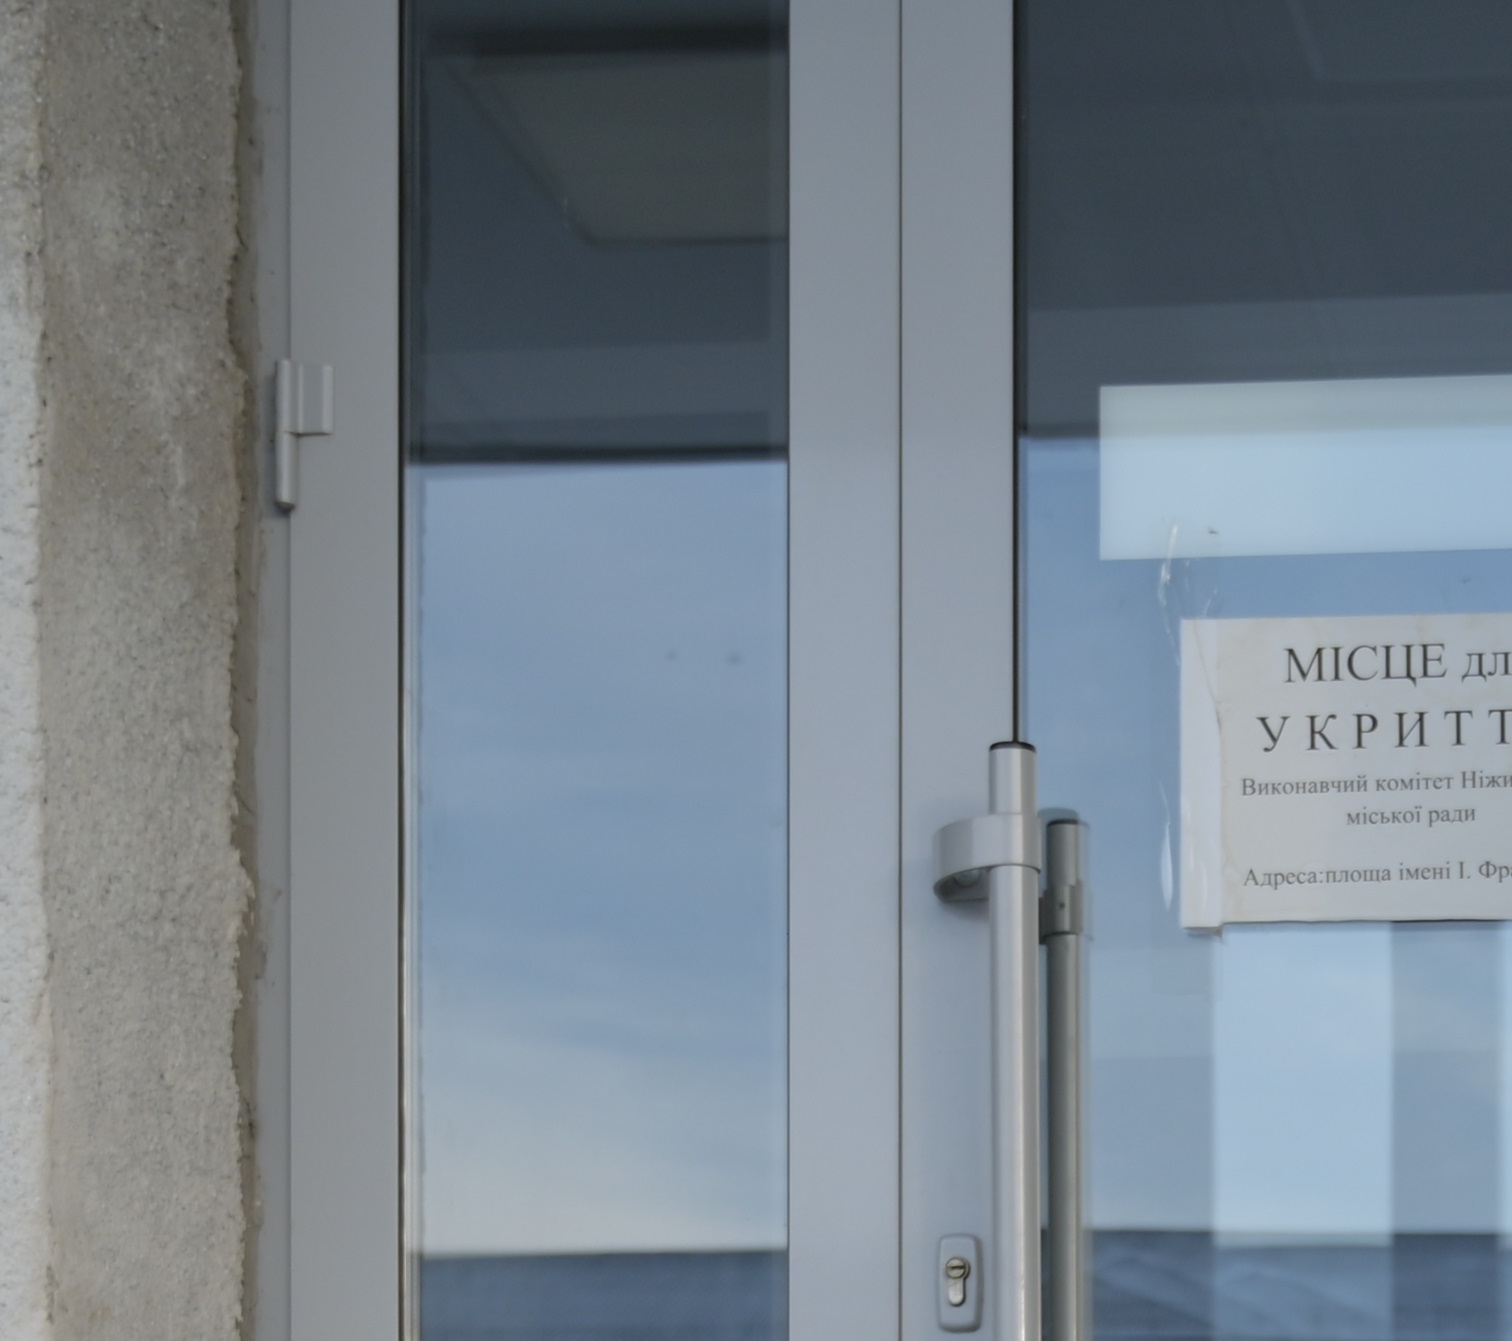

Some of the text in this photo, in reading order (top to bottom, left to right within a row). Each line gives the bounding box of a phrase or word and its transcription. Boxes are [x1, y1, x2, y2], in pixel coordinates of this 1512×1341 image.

[1284, 643, 1447, 687] МІСЦЕ
[1241, 775, 1369, 796] Виконавчий
[1375, 772, 1454, 792] комітет
[1346, 806, 1476, 828] міської ради
[1399, 862, 1451, 882] імені
